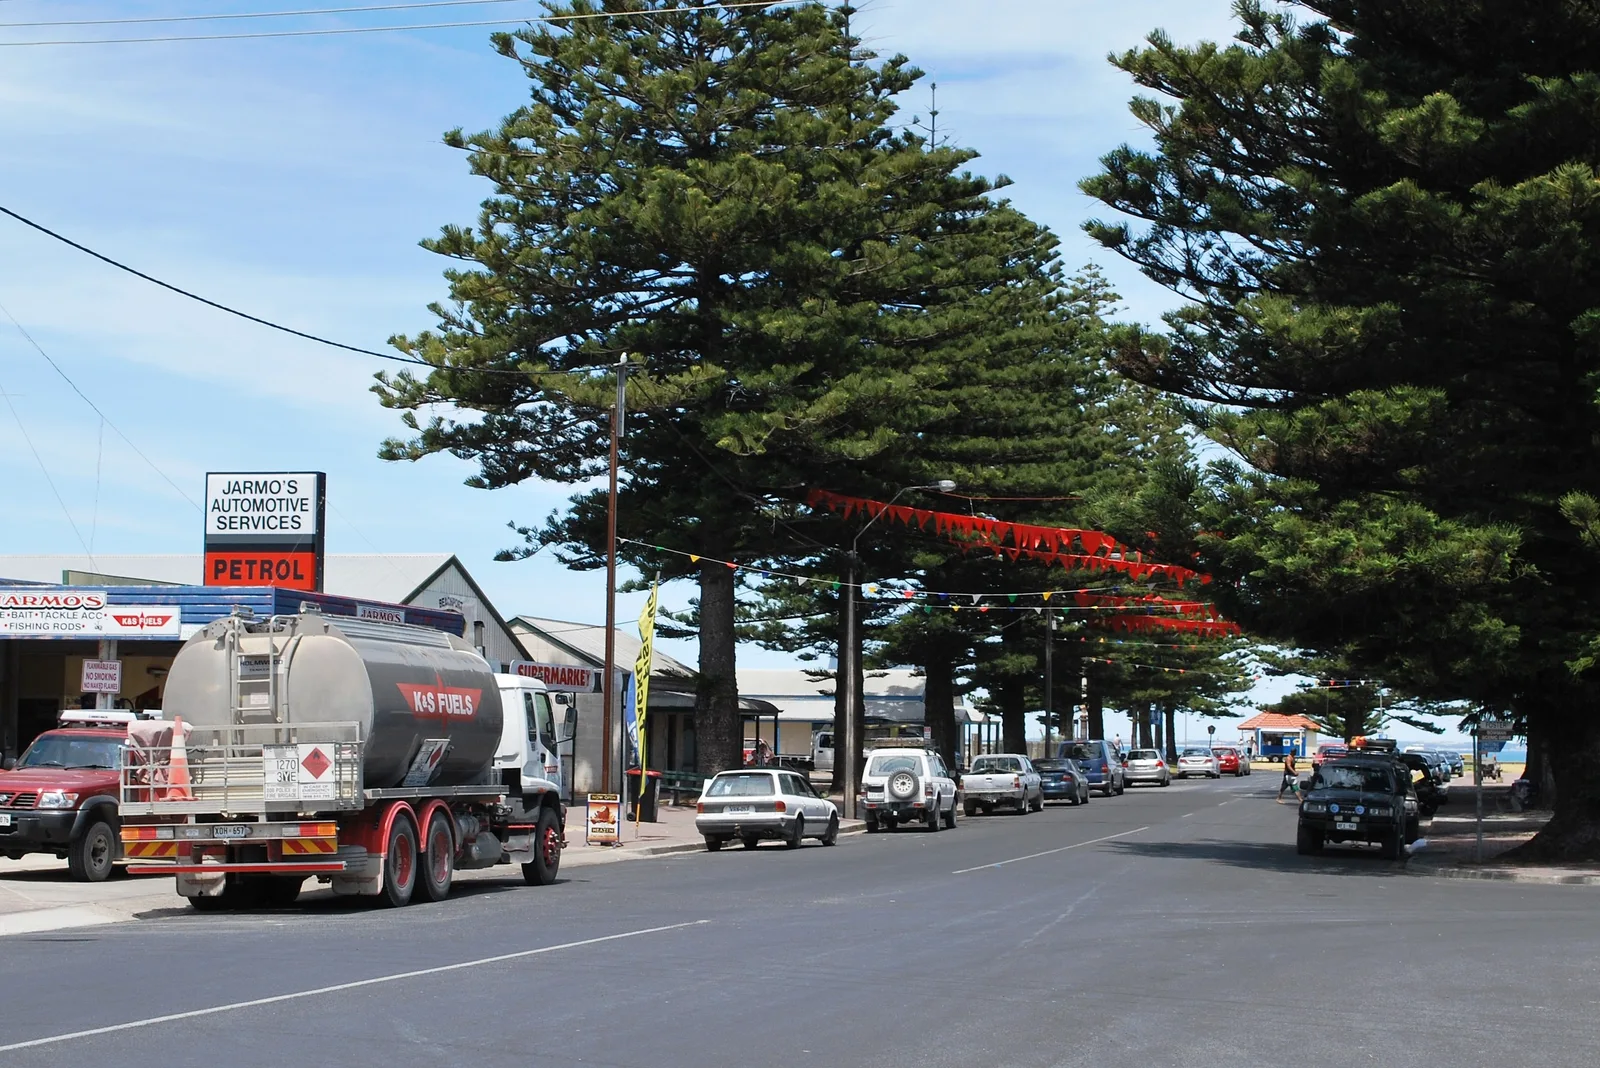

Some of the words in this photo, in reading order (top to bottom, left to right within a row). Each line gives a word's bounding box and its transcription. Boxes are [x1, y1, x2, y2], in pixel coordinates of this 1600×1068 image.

[222, 480, 298, 495] JARMO'S
[211, 498, 309, 513] AUTOMOTIVE
[216, 515, 302, 530] SERVICES
[213, 559, 304, 580] PETROL
[11, 611, 33, 619] BAIT
[40, 611, 78, 620] TACKLE
[81, 612, 103, 620] ACC
[121, 617, 138, 625] K&S
[139, 617, 163, 625] FUELS
[361, 609, 401, 623] JARMO'S
[9, 622, 50, 630] FISHING
[53, 622, 82, 631] RODS
[86, 672, 94, 680] NO
[94, 672, 117, 681] SMOKING
[517, 664, 591, 687] SUPERMARKET
[413, 691, 436, 713] K&S
[437, 693, 474, 715] FUELS
[276, 759, 297, 770] 1270
[276, 771, 297, 782] 3YE
